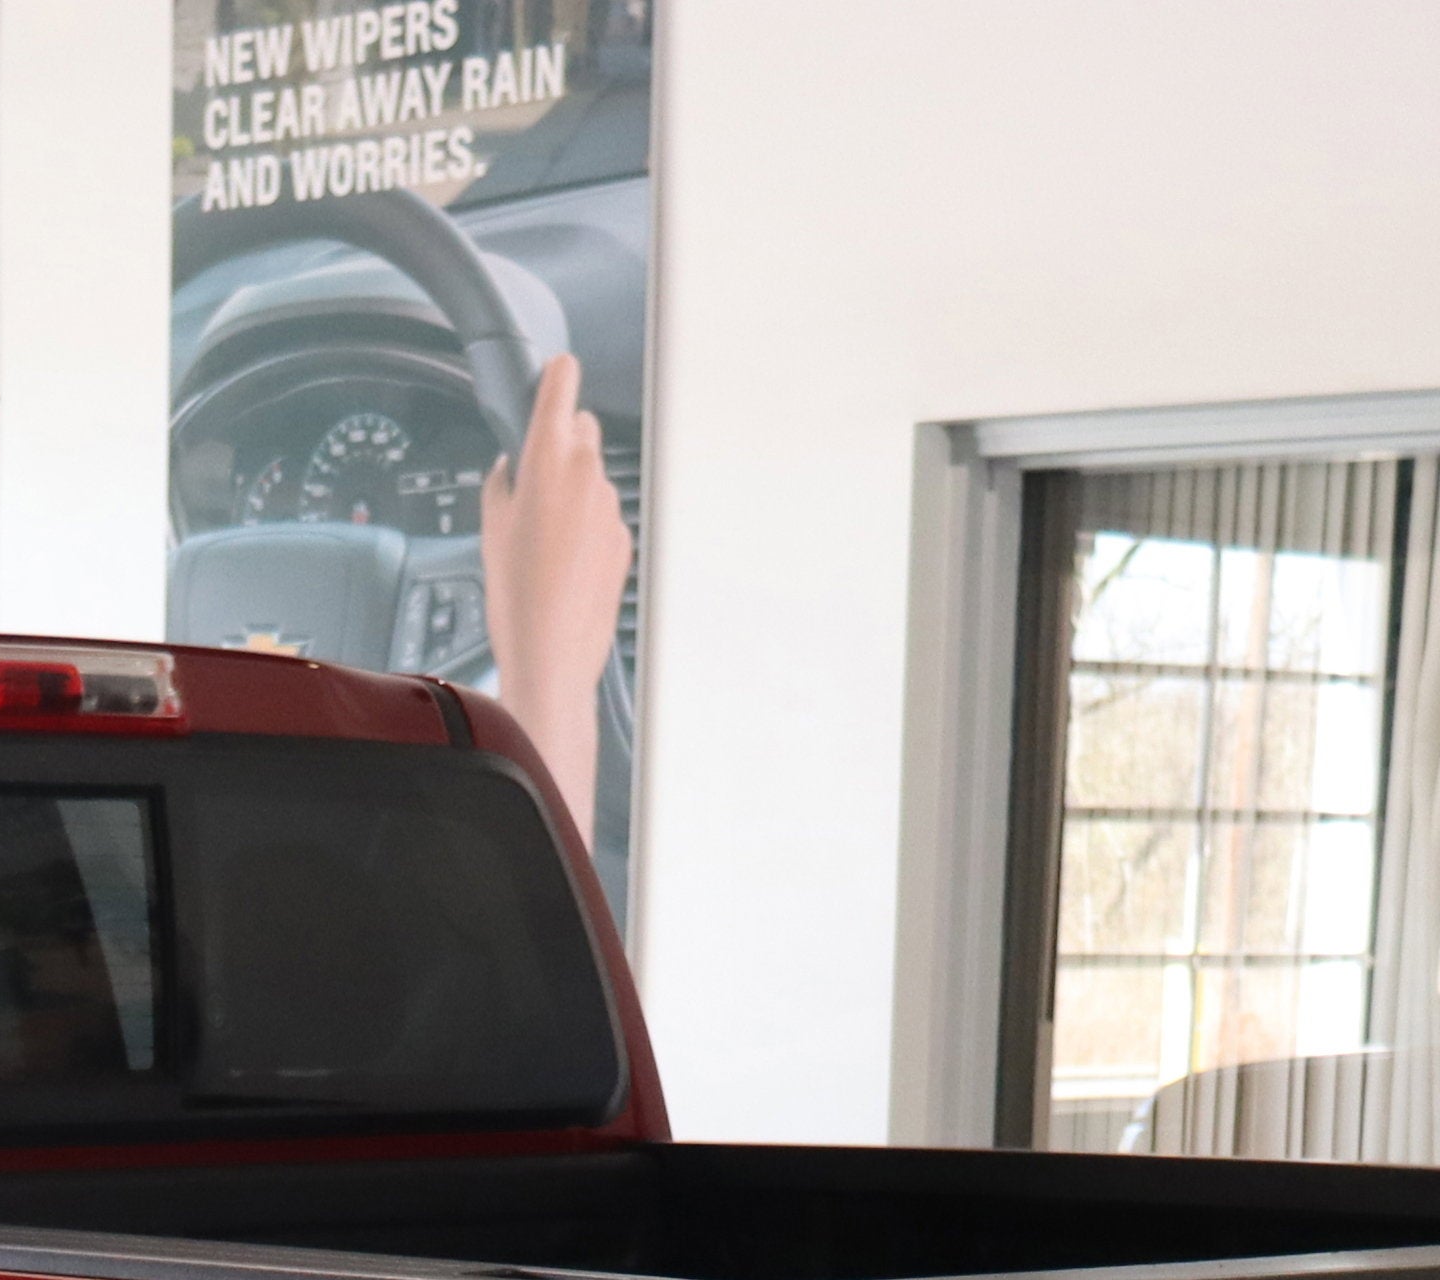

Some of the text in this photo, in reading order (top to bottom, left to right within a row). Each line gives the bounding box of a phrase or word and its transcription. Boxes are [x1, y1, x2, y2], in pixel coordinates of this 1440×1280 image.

[203, 0, 460, 88] NEW WIPERS
[203, 44, 565, 150] CLEAR AWAY RAIN
[202, 126, 488, 213] AND WORRIES.
